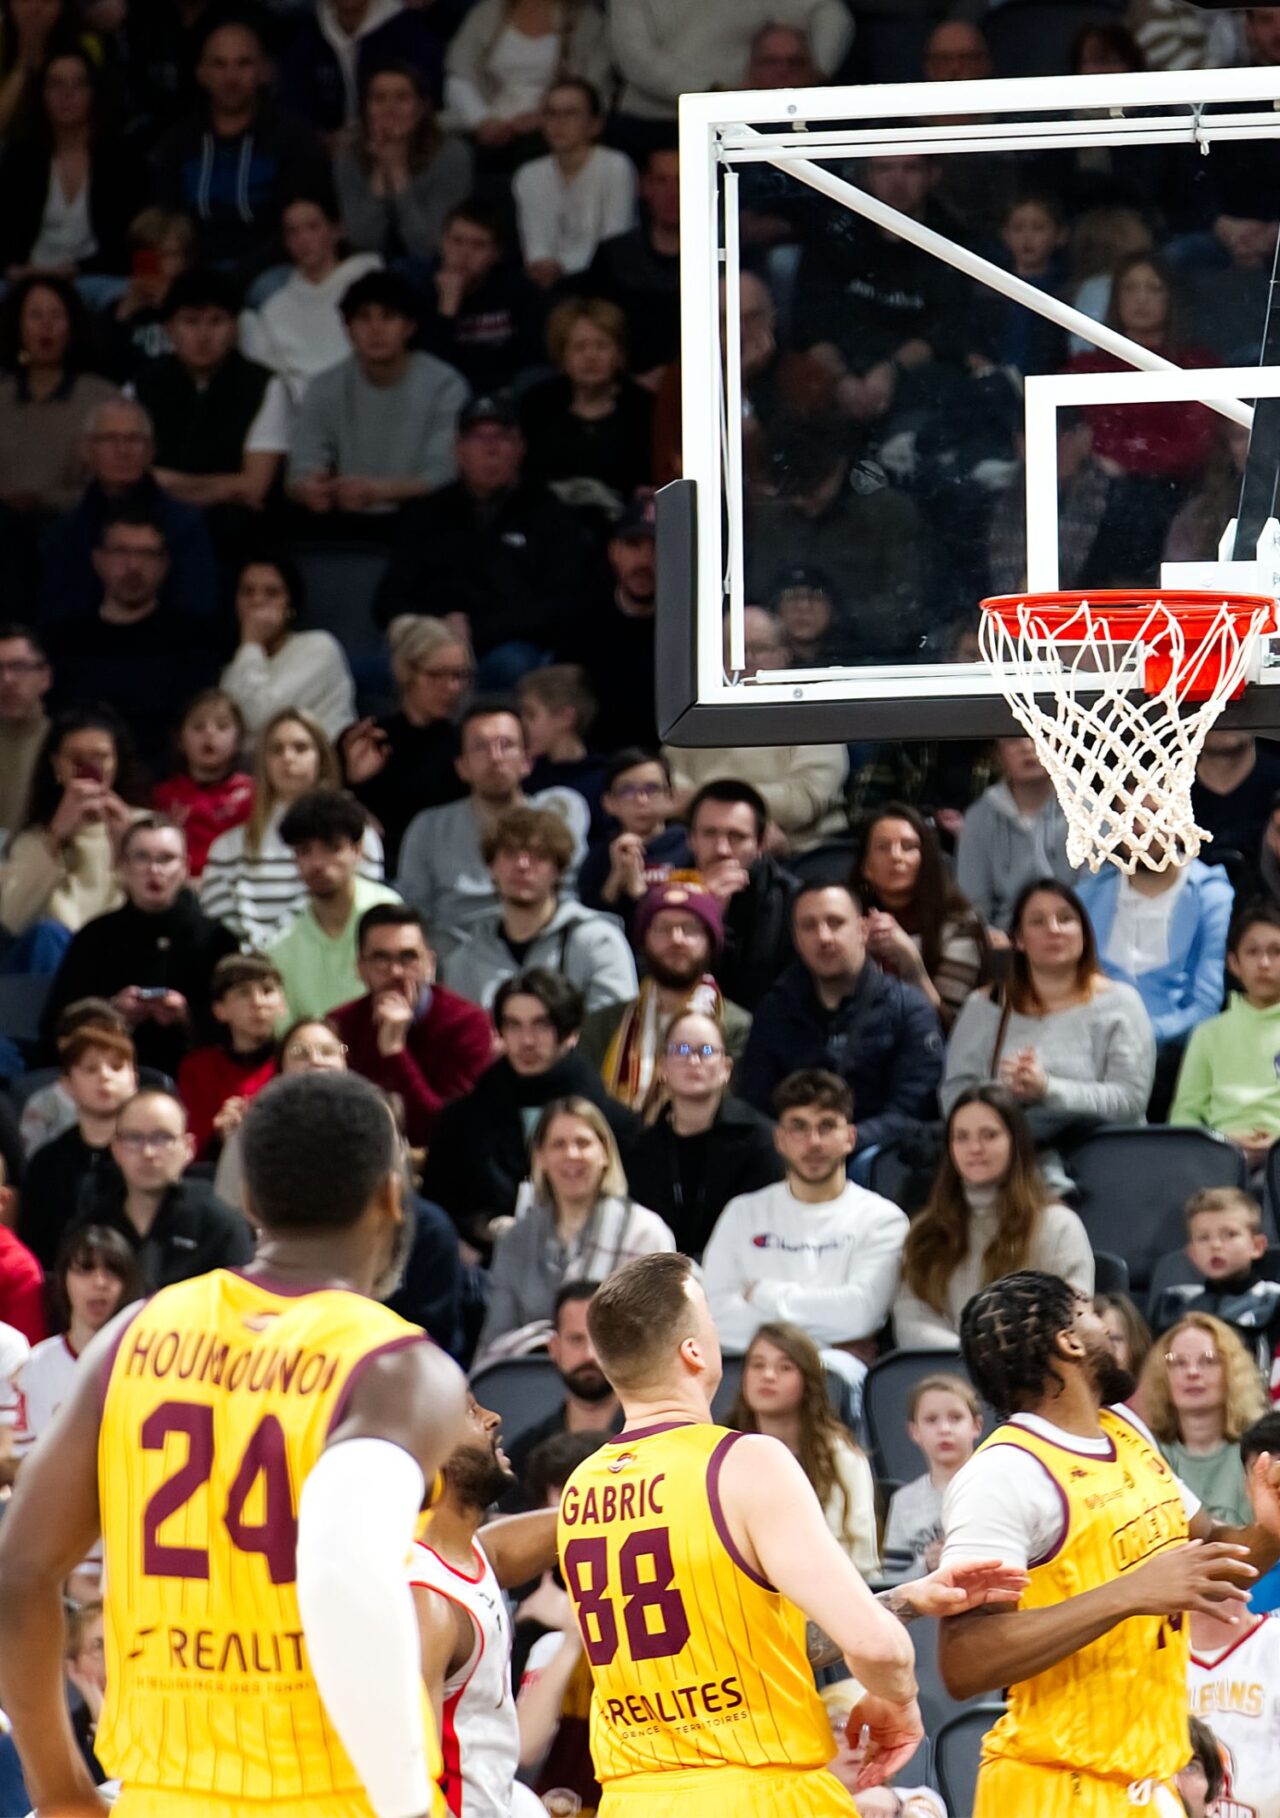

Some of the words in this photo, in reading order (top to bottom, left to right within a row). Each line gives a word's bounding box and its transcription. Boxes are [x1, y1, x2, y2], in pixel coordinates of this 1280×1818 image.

[141, 1401, 298, 1584] 24
[563, 1473, 665, 1526] GABRIC
[564, 1526, 691, 1666] 88
